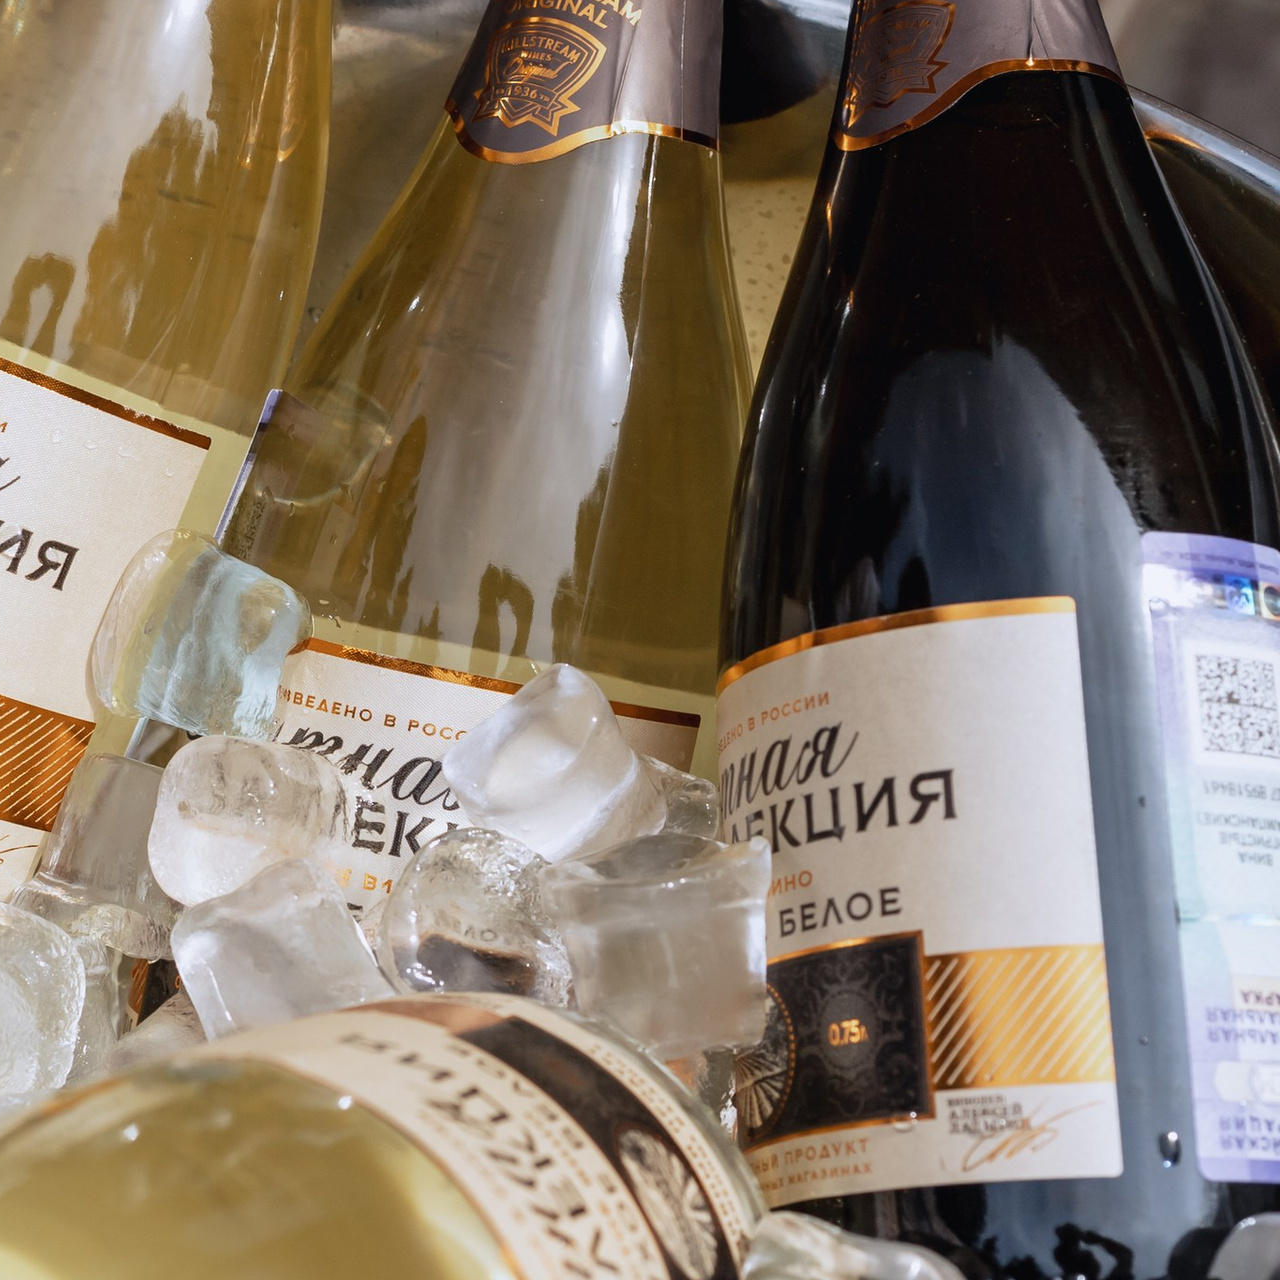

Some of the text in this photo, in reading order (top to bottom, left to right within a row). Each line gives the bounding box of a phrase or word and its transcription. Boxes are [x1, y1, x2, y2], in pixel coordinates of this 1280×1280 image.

[506, 84, 539, 101] 1936
[768, 870, 813, 897] ИНО
[779, 886, 903, 938] БЕЛОЕ
